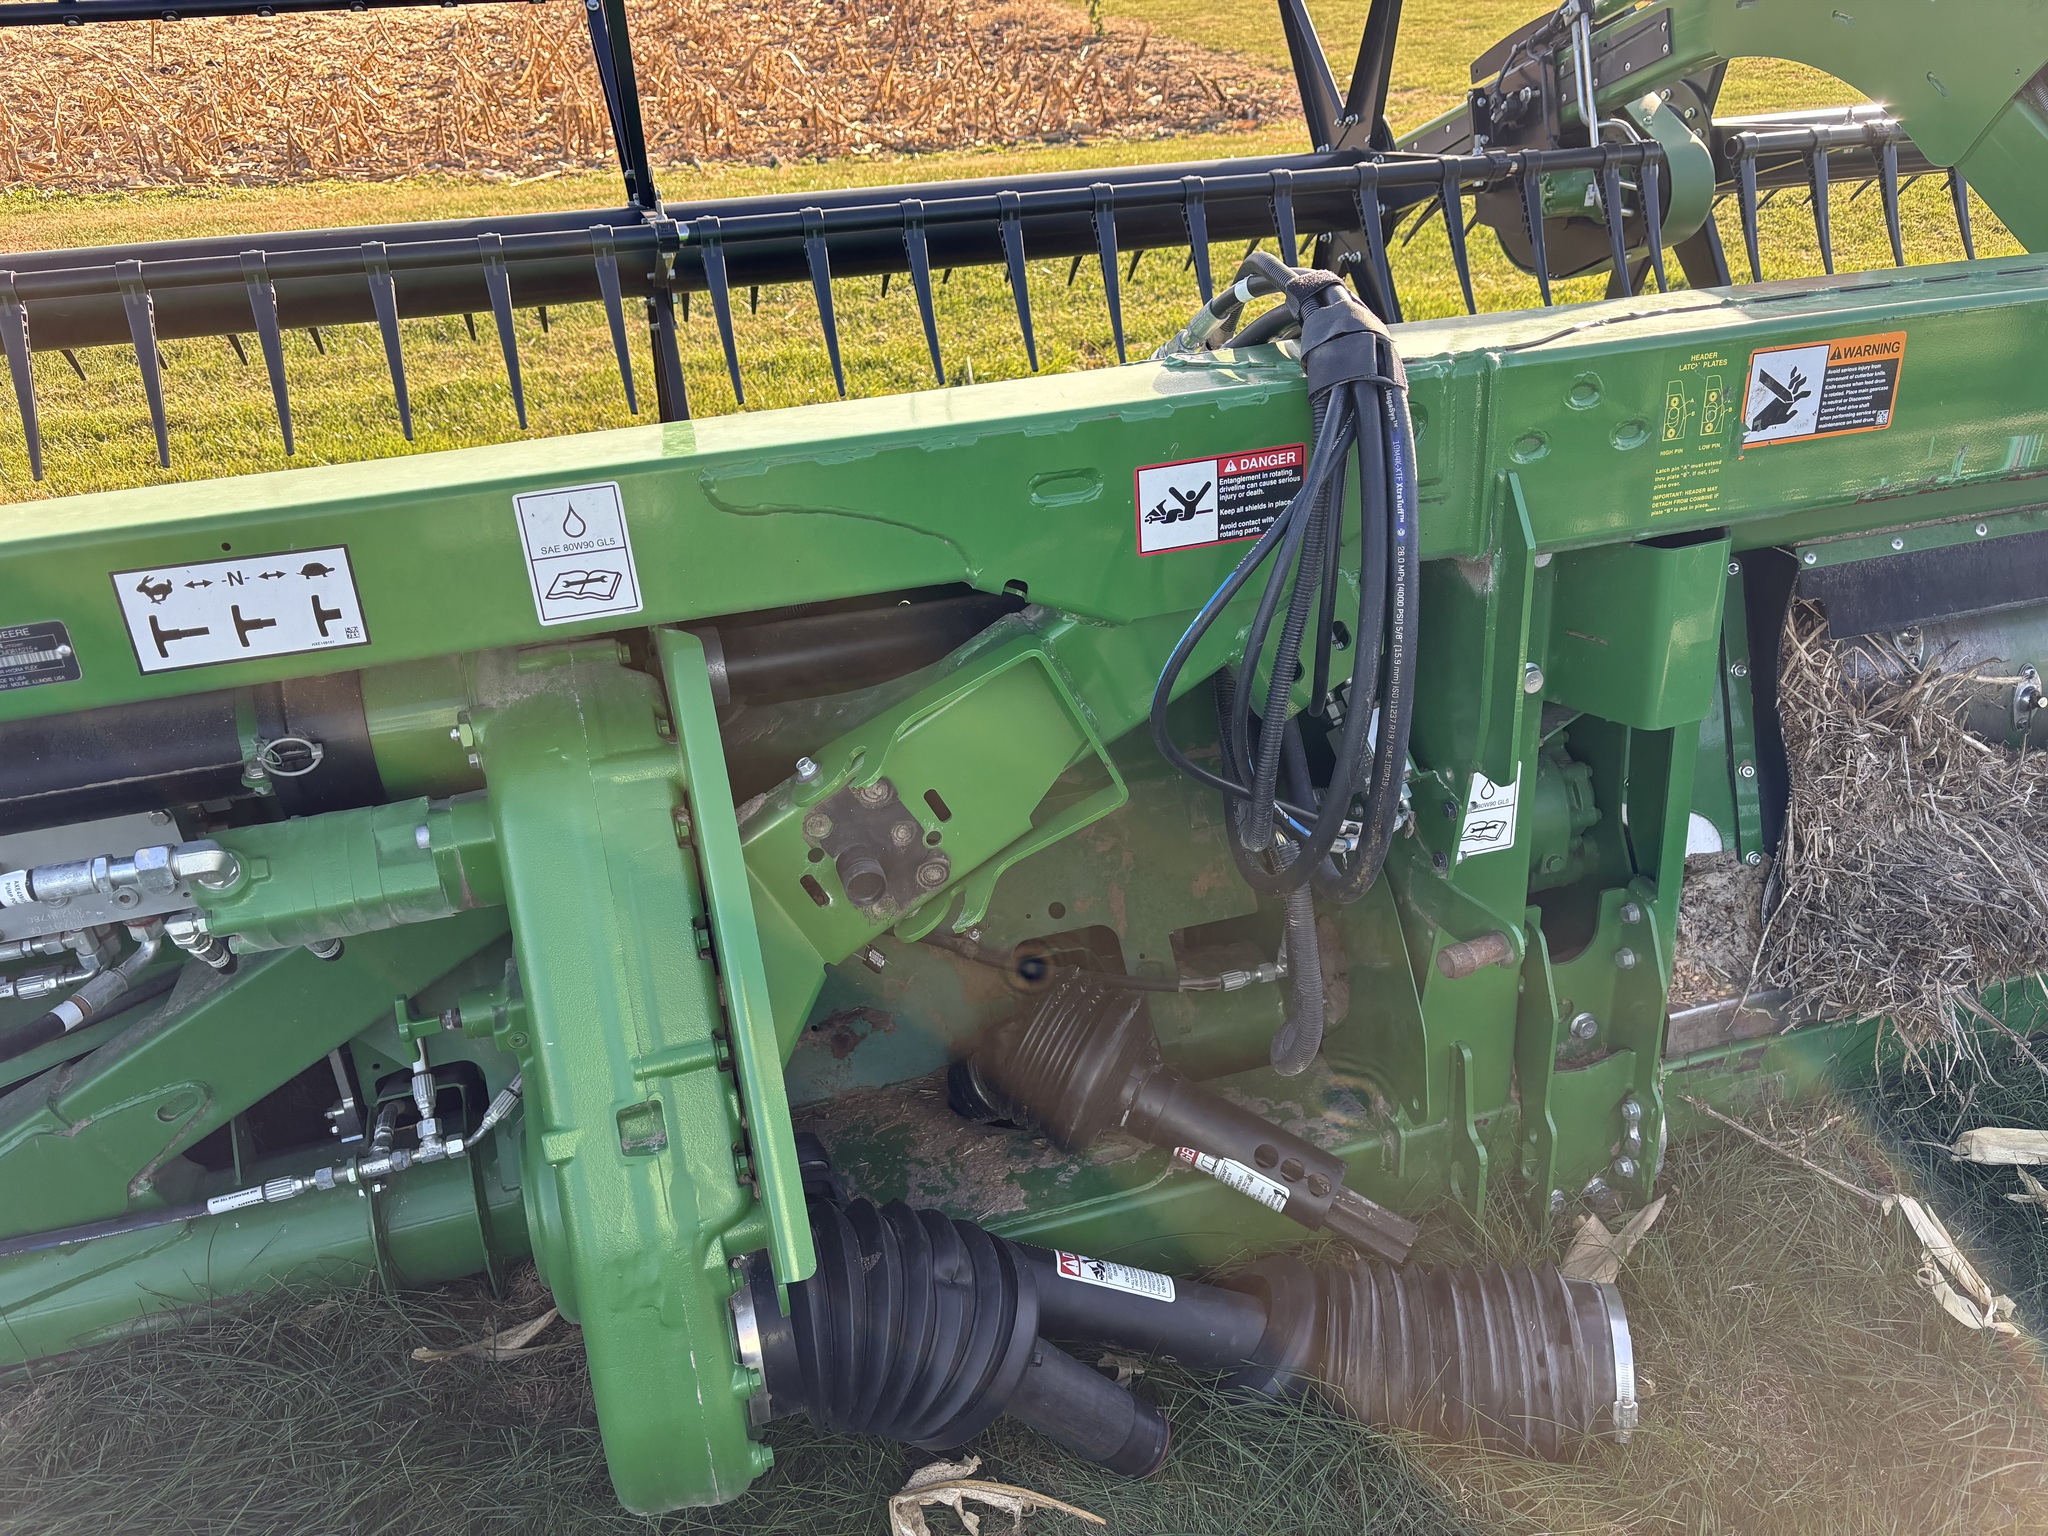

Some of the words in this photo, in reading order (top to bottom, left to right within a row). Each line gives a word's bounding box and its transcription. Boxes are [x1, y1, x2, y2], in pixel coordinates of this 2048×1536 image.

[1691, 352, 1718, 361] HEADER
[1844, 342, 1900, 358] WARNING
[1703, 359, 1728, 368] PLATES
[1832, 412, 1855, 420] performing
[1241, 452, 1295, 470] DANGER
[1220, 474, 1261, 486] Entanglement
[1270, 469, 1292, 477] rotating
[1220, 484, 1245, 493] driveline
[1278, 475, 1300, 483] serious
[1220, 493, 1237, 501] injury
[1653, 491, 1683, 500] IMPORTANT:
[1690, 494, 1713, 502] COMBINE
[1245, 503, 1266, 511] shields
[1220, 522, 1237, 530] Avoid
[1238, 518, 1260, 527] contact
[1220, 529, 1243, 538] rotating
[1245, 526, 1261, 535] parts.
[540, 544, 561, 555] SAE
[563, 540, 595, 552] 80W90
[596, 537, 616, 548] GL5
[1397, 546, 1405, 563] 28.0
[1397, 565, 1405, 583] MPa
[1391, 685, 1399, 699] ISO
[1389, 700, 1399, 724] 11237
[1387, 724, 1396, 740] R19
[1385, 744, 1394, 759] SAE
[1381, 759, 1392, 787] 100R19
[1497, 798, 1510, 806] GL5
